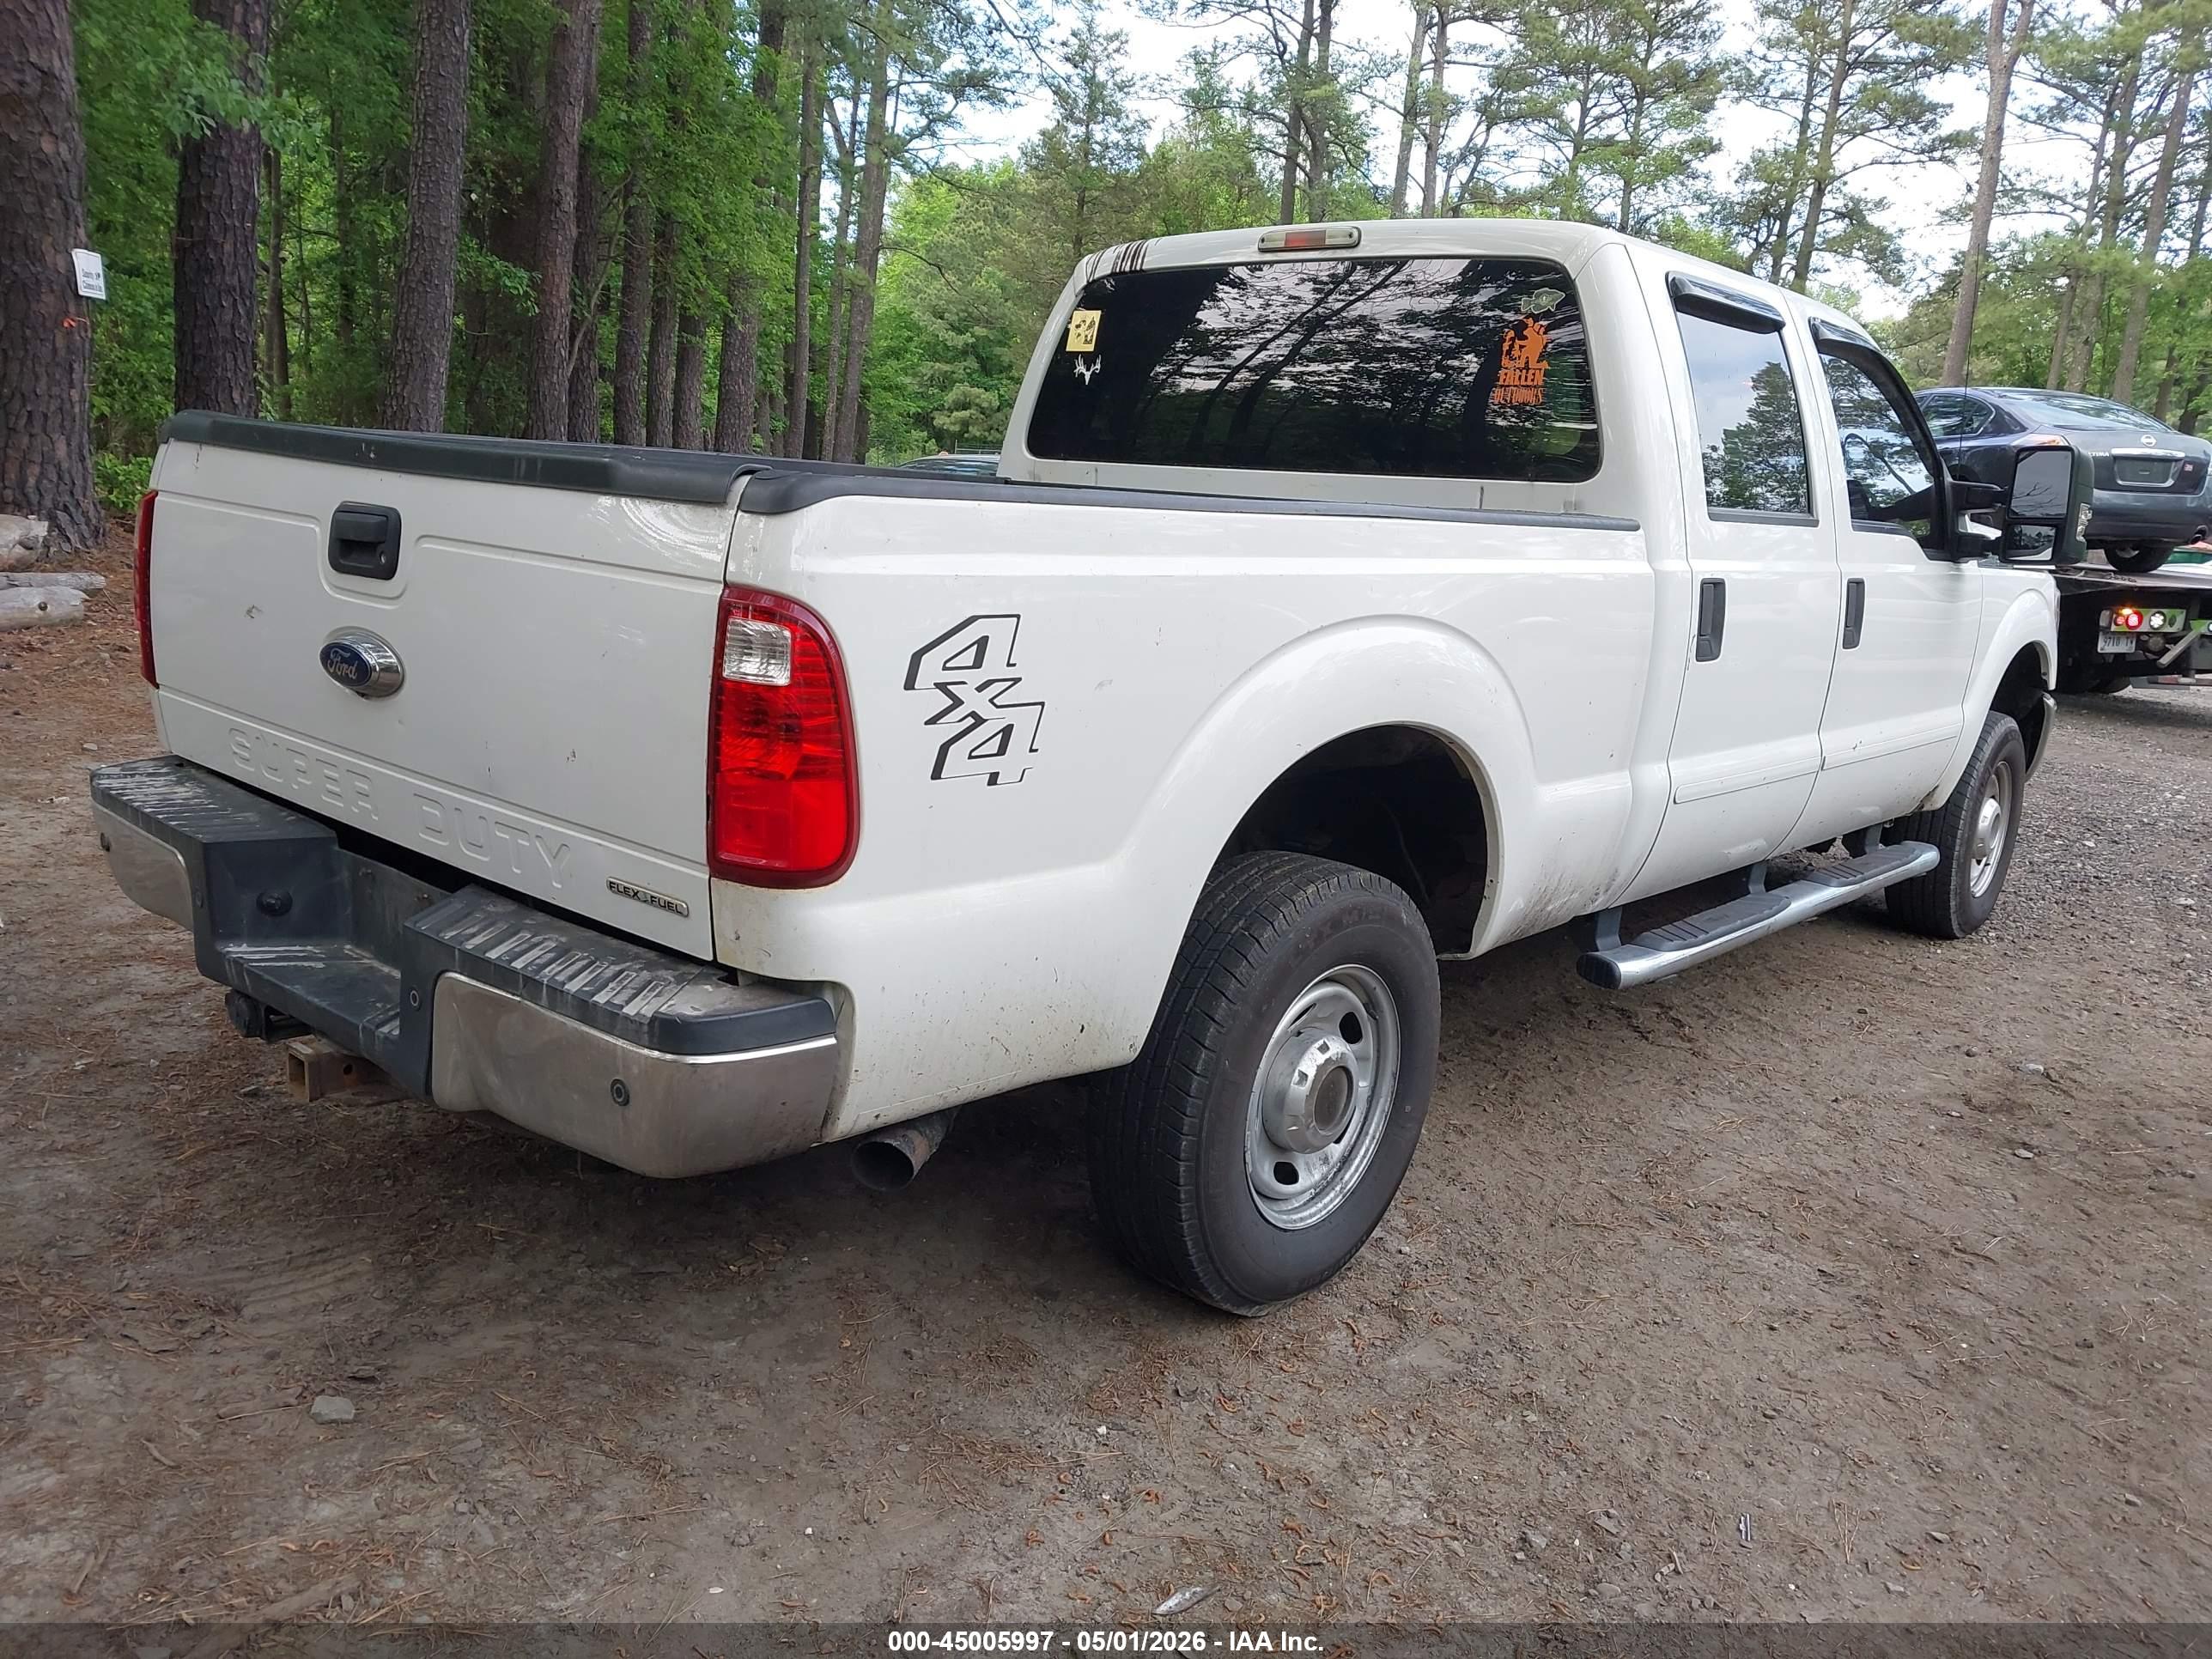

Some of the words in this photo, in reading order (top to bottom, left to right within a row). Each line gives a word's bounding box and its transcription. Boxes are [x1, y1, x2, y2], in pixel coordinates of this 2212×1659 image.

[1499, 368, 1545, 386] FALLEN
[327, 647, 358, 680] Ford
[228, 727, 379, 821] SUPER
[413, 793, 571, 889] DUTY
[609, 881, 641, 901] FLEX
[650, 895, 684, 915] FUEL
